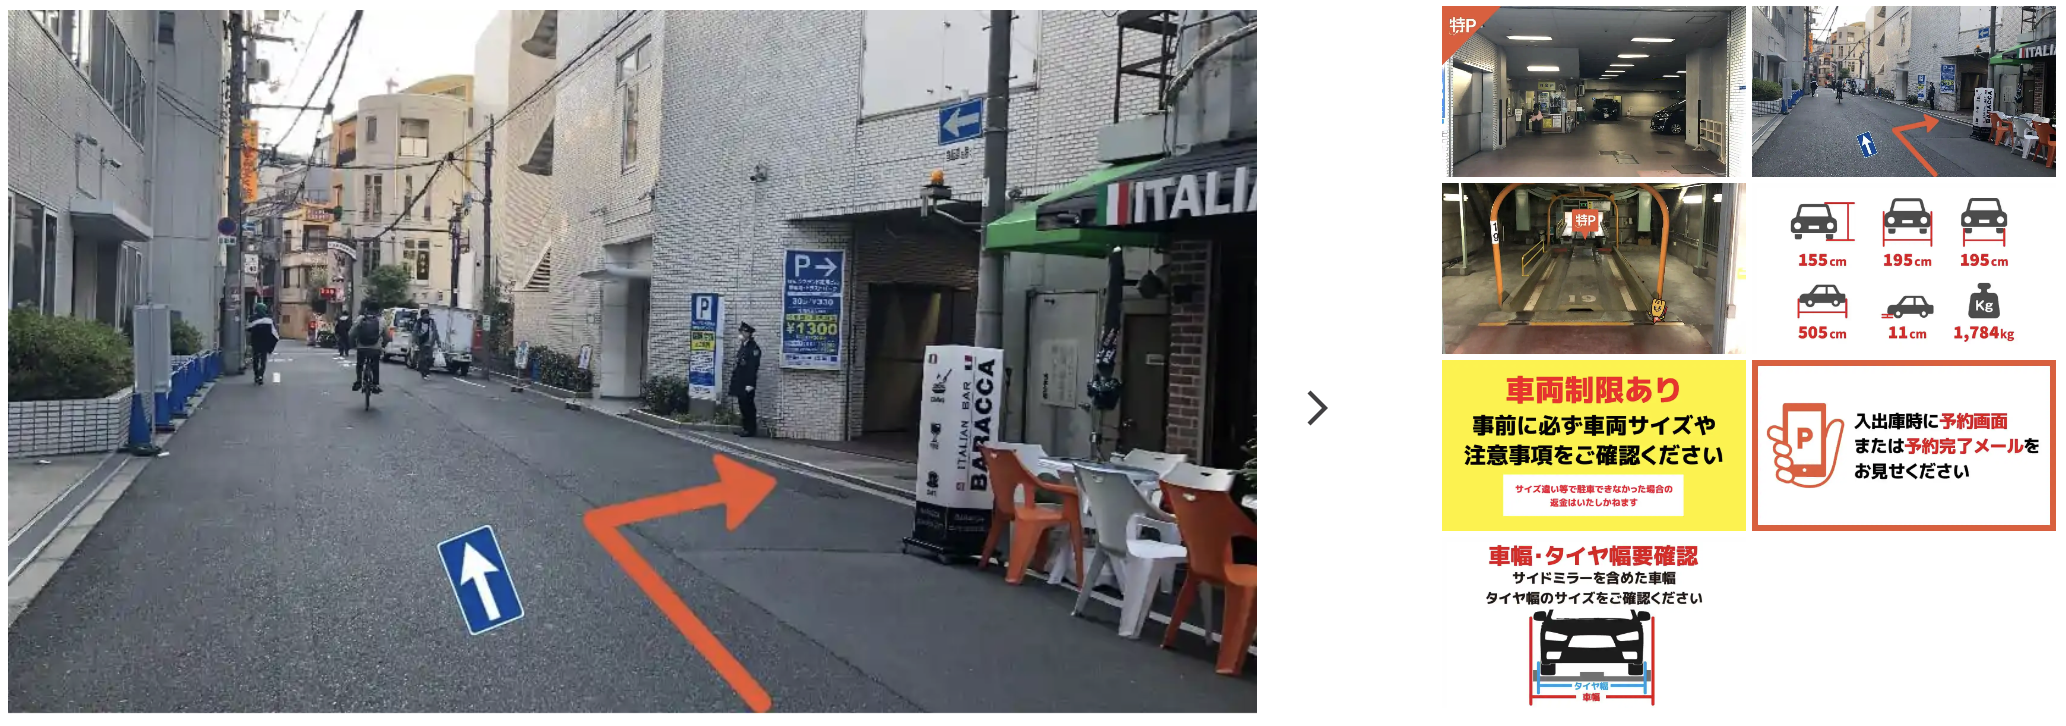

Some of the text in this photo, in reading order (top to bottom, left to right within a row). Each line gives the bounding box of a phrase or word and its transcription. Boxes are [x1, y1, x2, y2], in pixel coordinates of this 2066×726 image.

[794, 254, 811, 277] P
[700, 297, 709, 318] P
[1975, 300, 1994, 313] Kg
[786, 321, 838, 336] ¥1300
[1506, 375, 1680, 405] 車両制限あり
[957, 381, 972, 470] ITALIAN BAR
[1472, 415, 1716, 437] 事前に必ず車両サイズや
[1854, 412, 2008, 430] 入出庫時に予約画面
[1797, 427, 1813, 449] P
[1854, 438, 2039, 455] または予約完了メールを
[1464, 444, 1723, 466] 注意事項をご確認ください
[1854, 462, 1970, 480] お見せください
[1515, 484, 1673, 494] サイズ違い等で駐車できなかった場合の
[1550, 498, 1638, 507] 返金はいたしかねます
[1512, 571, 1676, 585] サイドミラーを含めた車幅
[1486, 591, 1703, 605] タイヤ幅のサイズをご確認ください
[1574, 682, 1608, 691] タイヤ幅
[1582, 692, 1600, 702] 車幅
